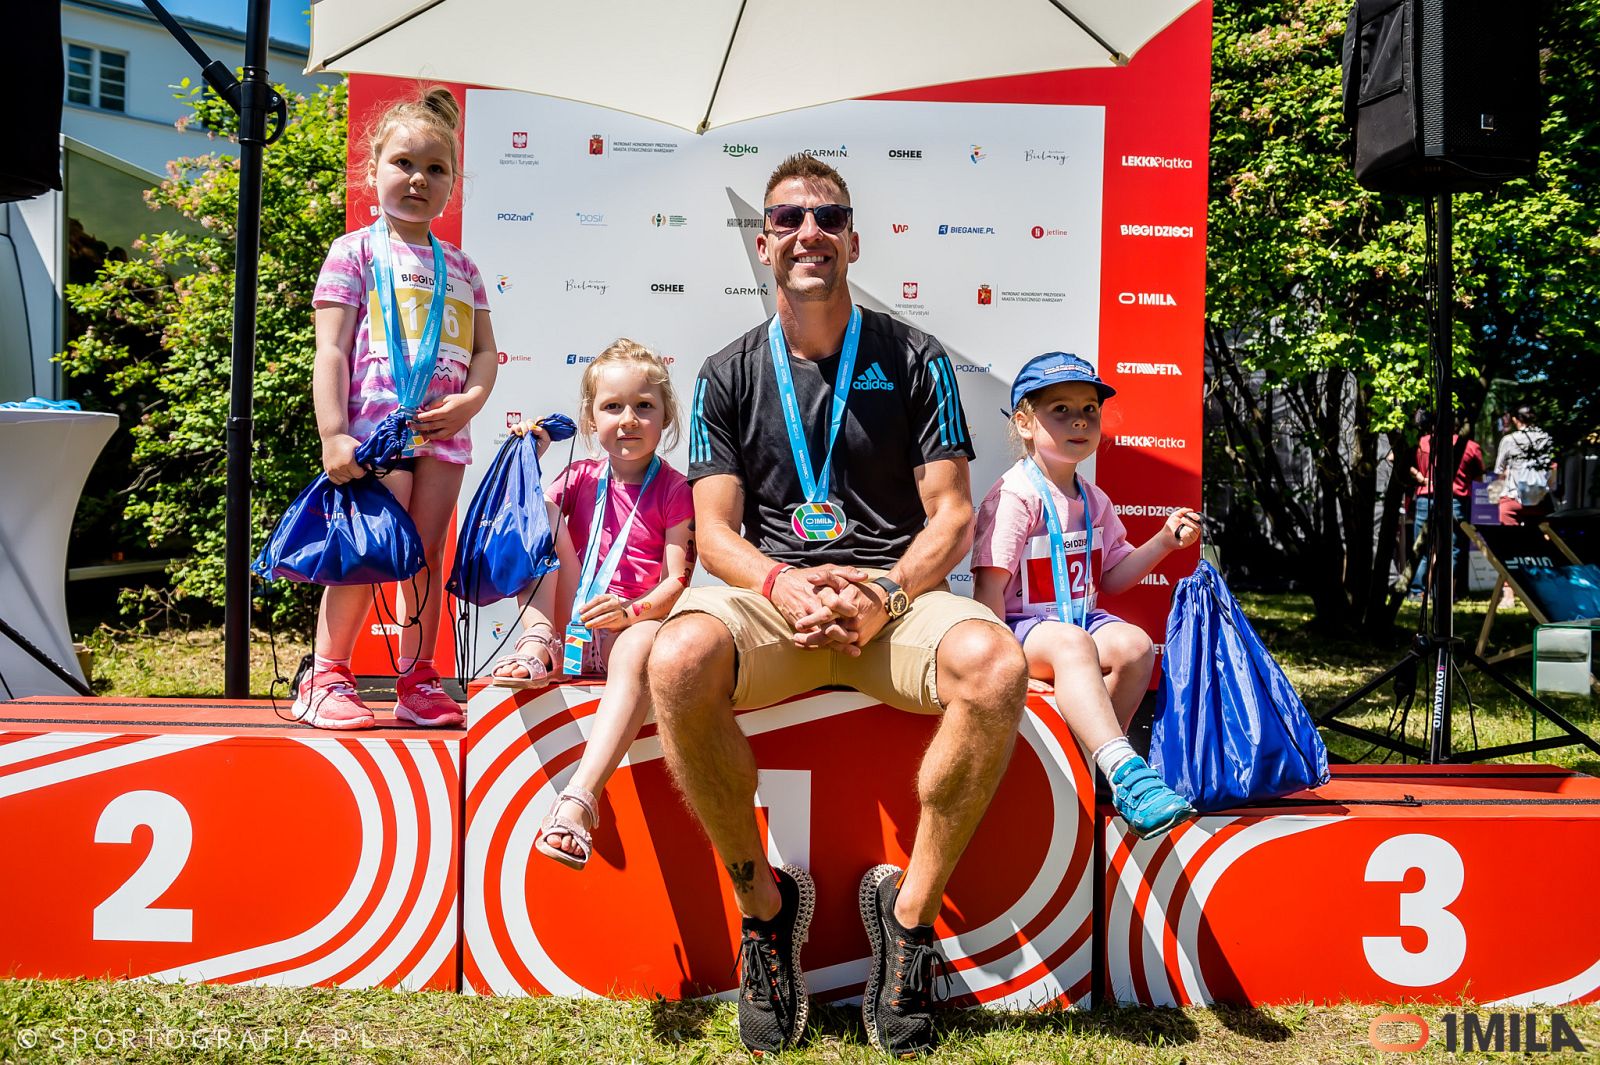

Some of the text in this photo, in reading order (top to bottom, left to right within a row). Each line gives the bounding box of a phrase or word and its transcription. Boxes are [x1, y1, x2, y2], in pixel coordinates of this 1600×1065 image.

[723, 144, 758, 157] żabka
[804, 149, 848, 157] GARMIN
[888, 149, 922, 158] OSHEE
[744, 218, 764, 229] SPORTO
[950, 226, 996, 236] BIEGANIE.PL
[1046, 228, 1068, 237] jetline
[650, 283, 685, 293] OSHEE
[724, 287, 769, 296] GARMIN
[510, 354, 532, 362] jetline
[852, 379, 894, 391] adidas
[93, 790, 193, 943] 2
[1362, 833, 1467, 988] 3
